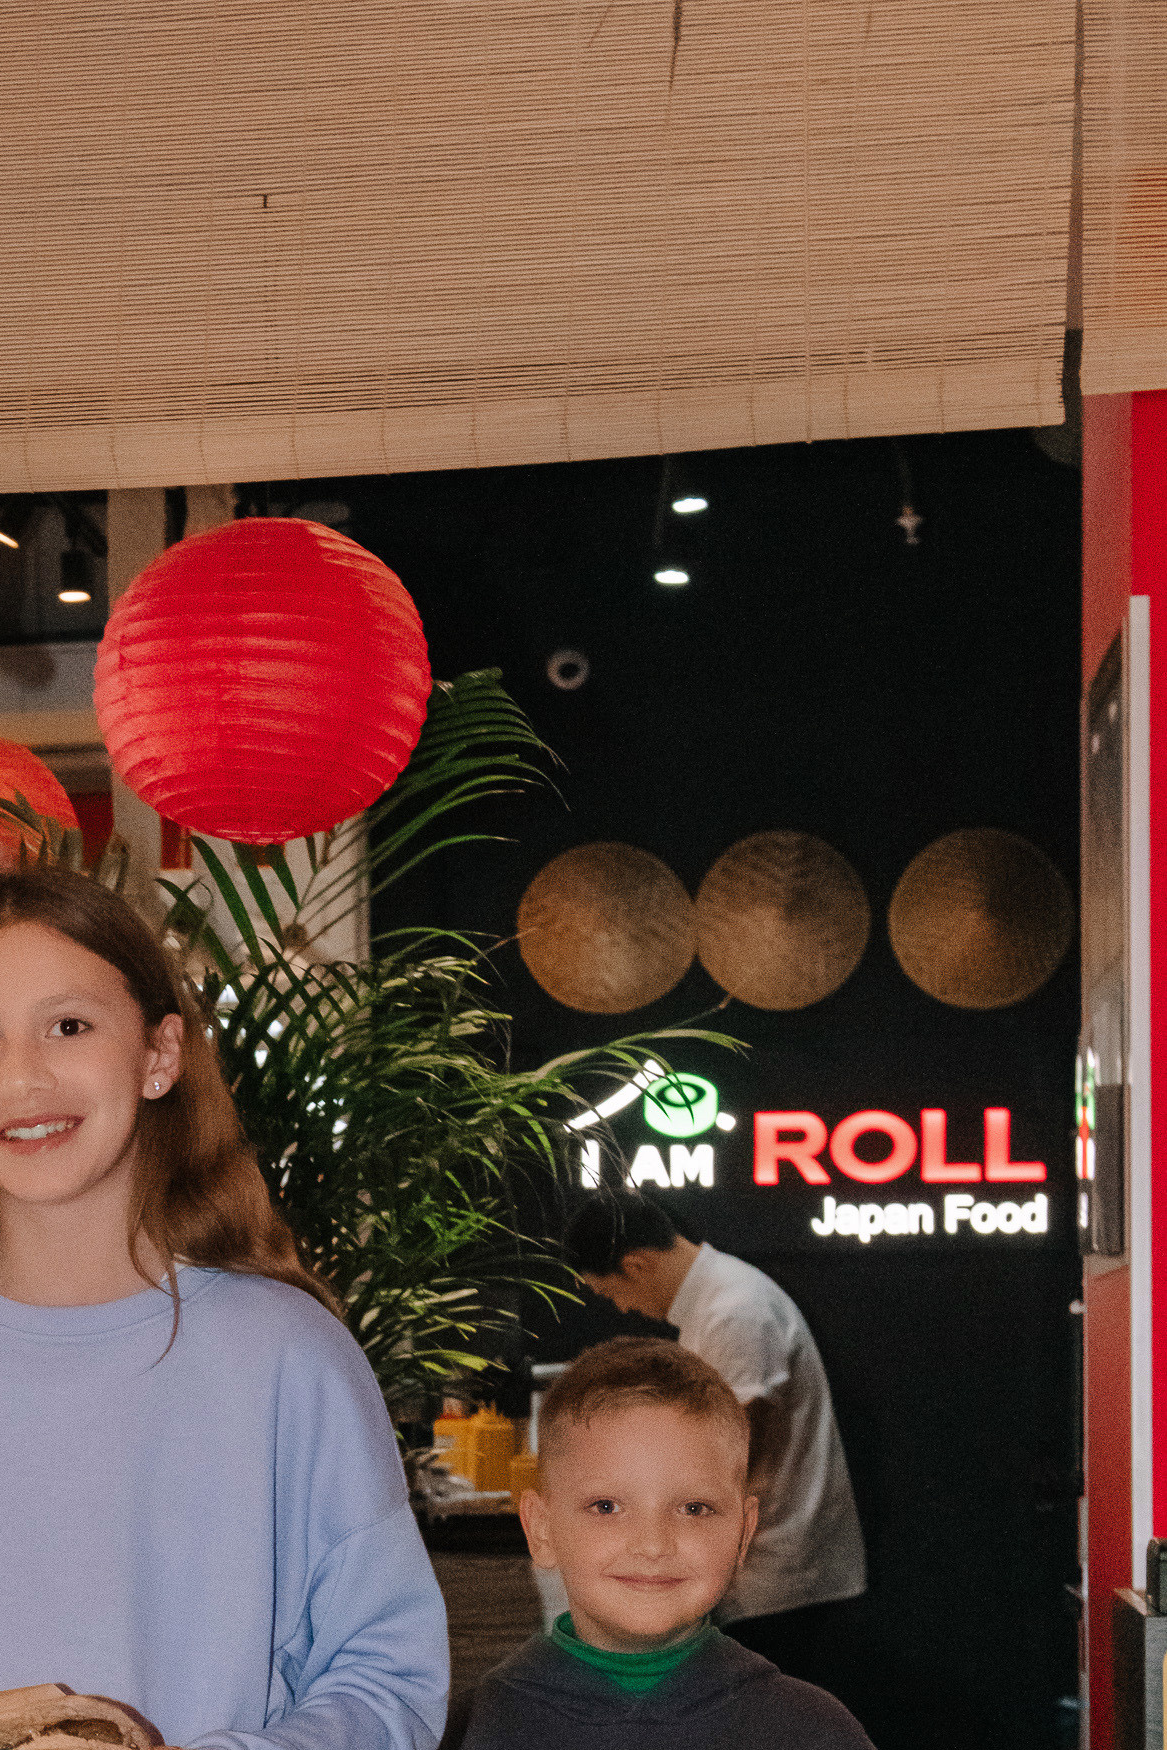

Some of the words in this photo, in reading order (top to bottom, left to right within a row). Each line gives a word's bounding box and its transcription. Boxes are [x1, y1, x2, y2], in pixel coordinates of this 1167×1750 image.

[580, 1138, 601, 1190] I
[625, 1143, 715, 1189] AM
[753, 1106, 1048, 1187] ROLL
[810, 1196, 936, 1243] Japan
[943, 1193, 1049, 1235] Food
